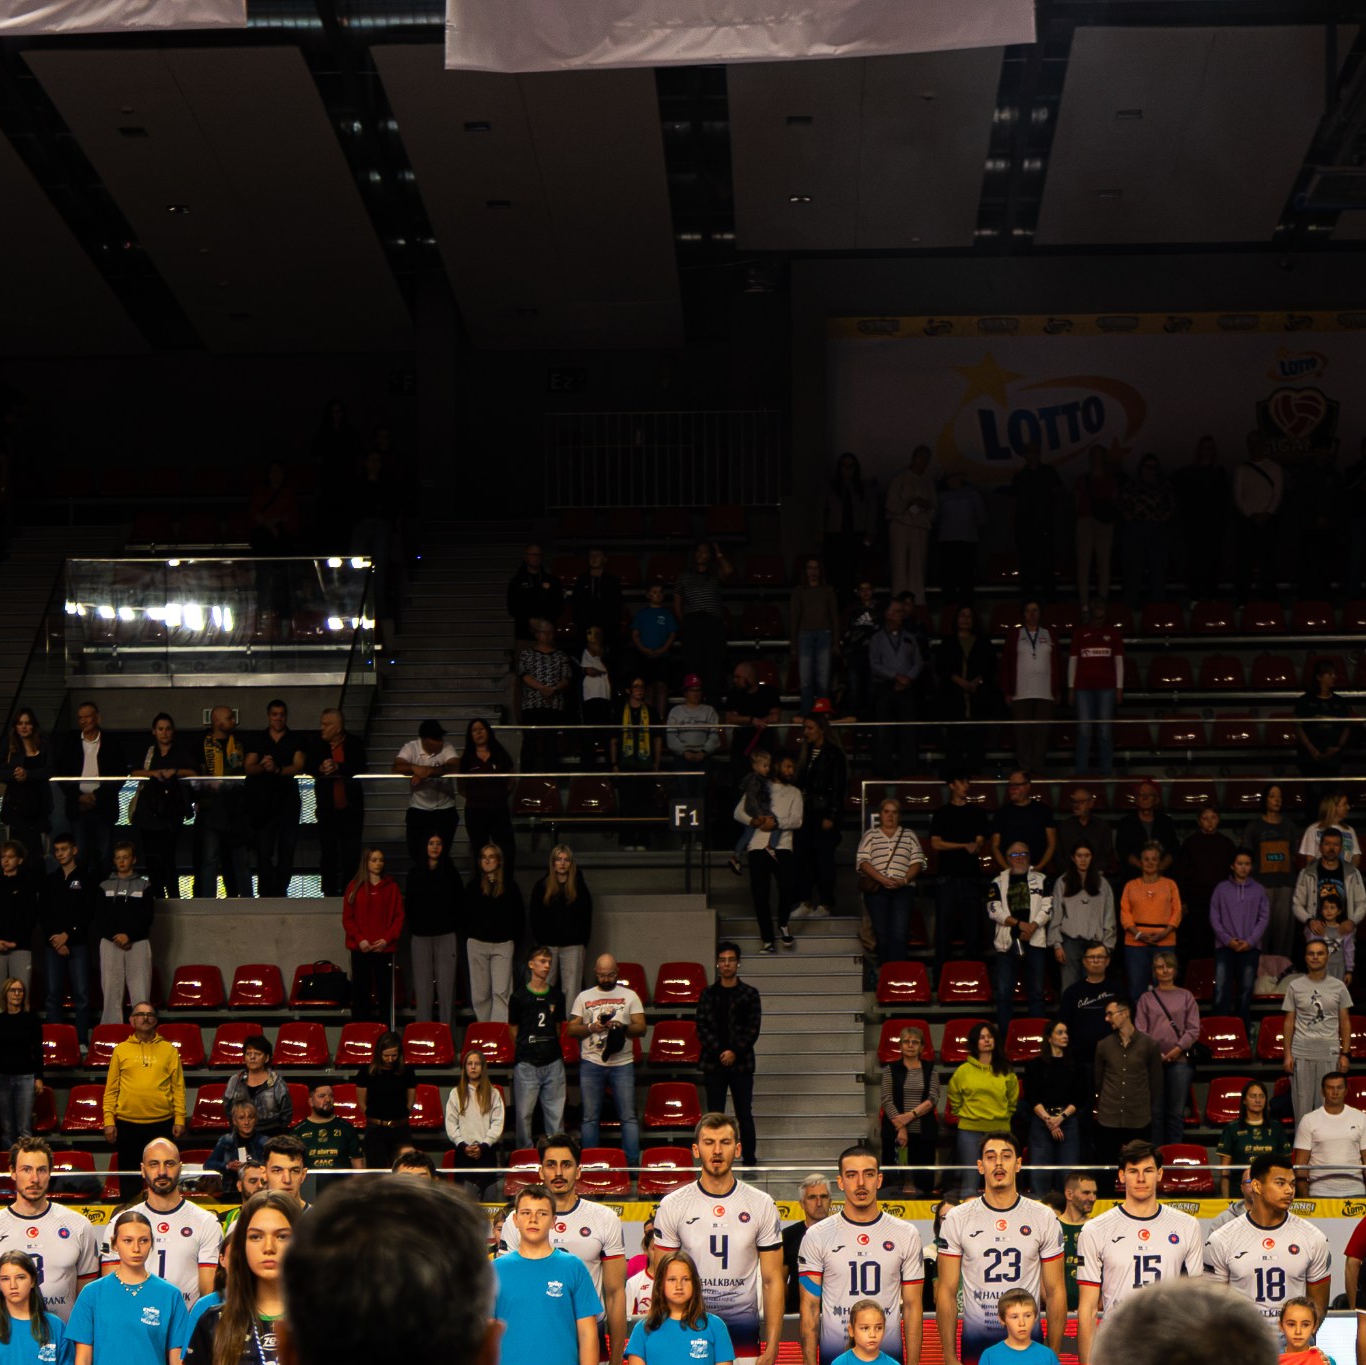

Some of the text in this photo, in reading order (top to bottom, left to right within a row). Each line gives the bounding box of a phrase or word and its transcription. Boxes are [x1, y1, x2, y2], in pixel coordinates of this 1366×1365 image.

[1279, 358, 1319, 378] LOTTO
[978, 396, 1104, 460] LOTTO
[675, 805, 699, 826] F1
[870, 814, 881, 829] E
[538, 1013, 546, 1028] 2
[709, 1235, 728, 1270] 4
[983, 1247, 1021, 1283] 23
[849, 1261, 881, 1296] 10
[1133, 1255, 1162, 1289] 15
[1254, 1266, 1286, 1303] 18
